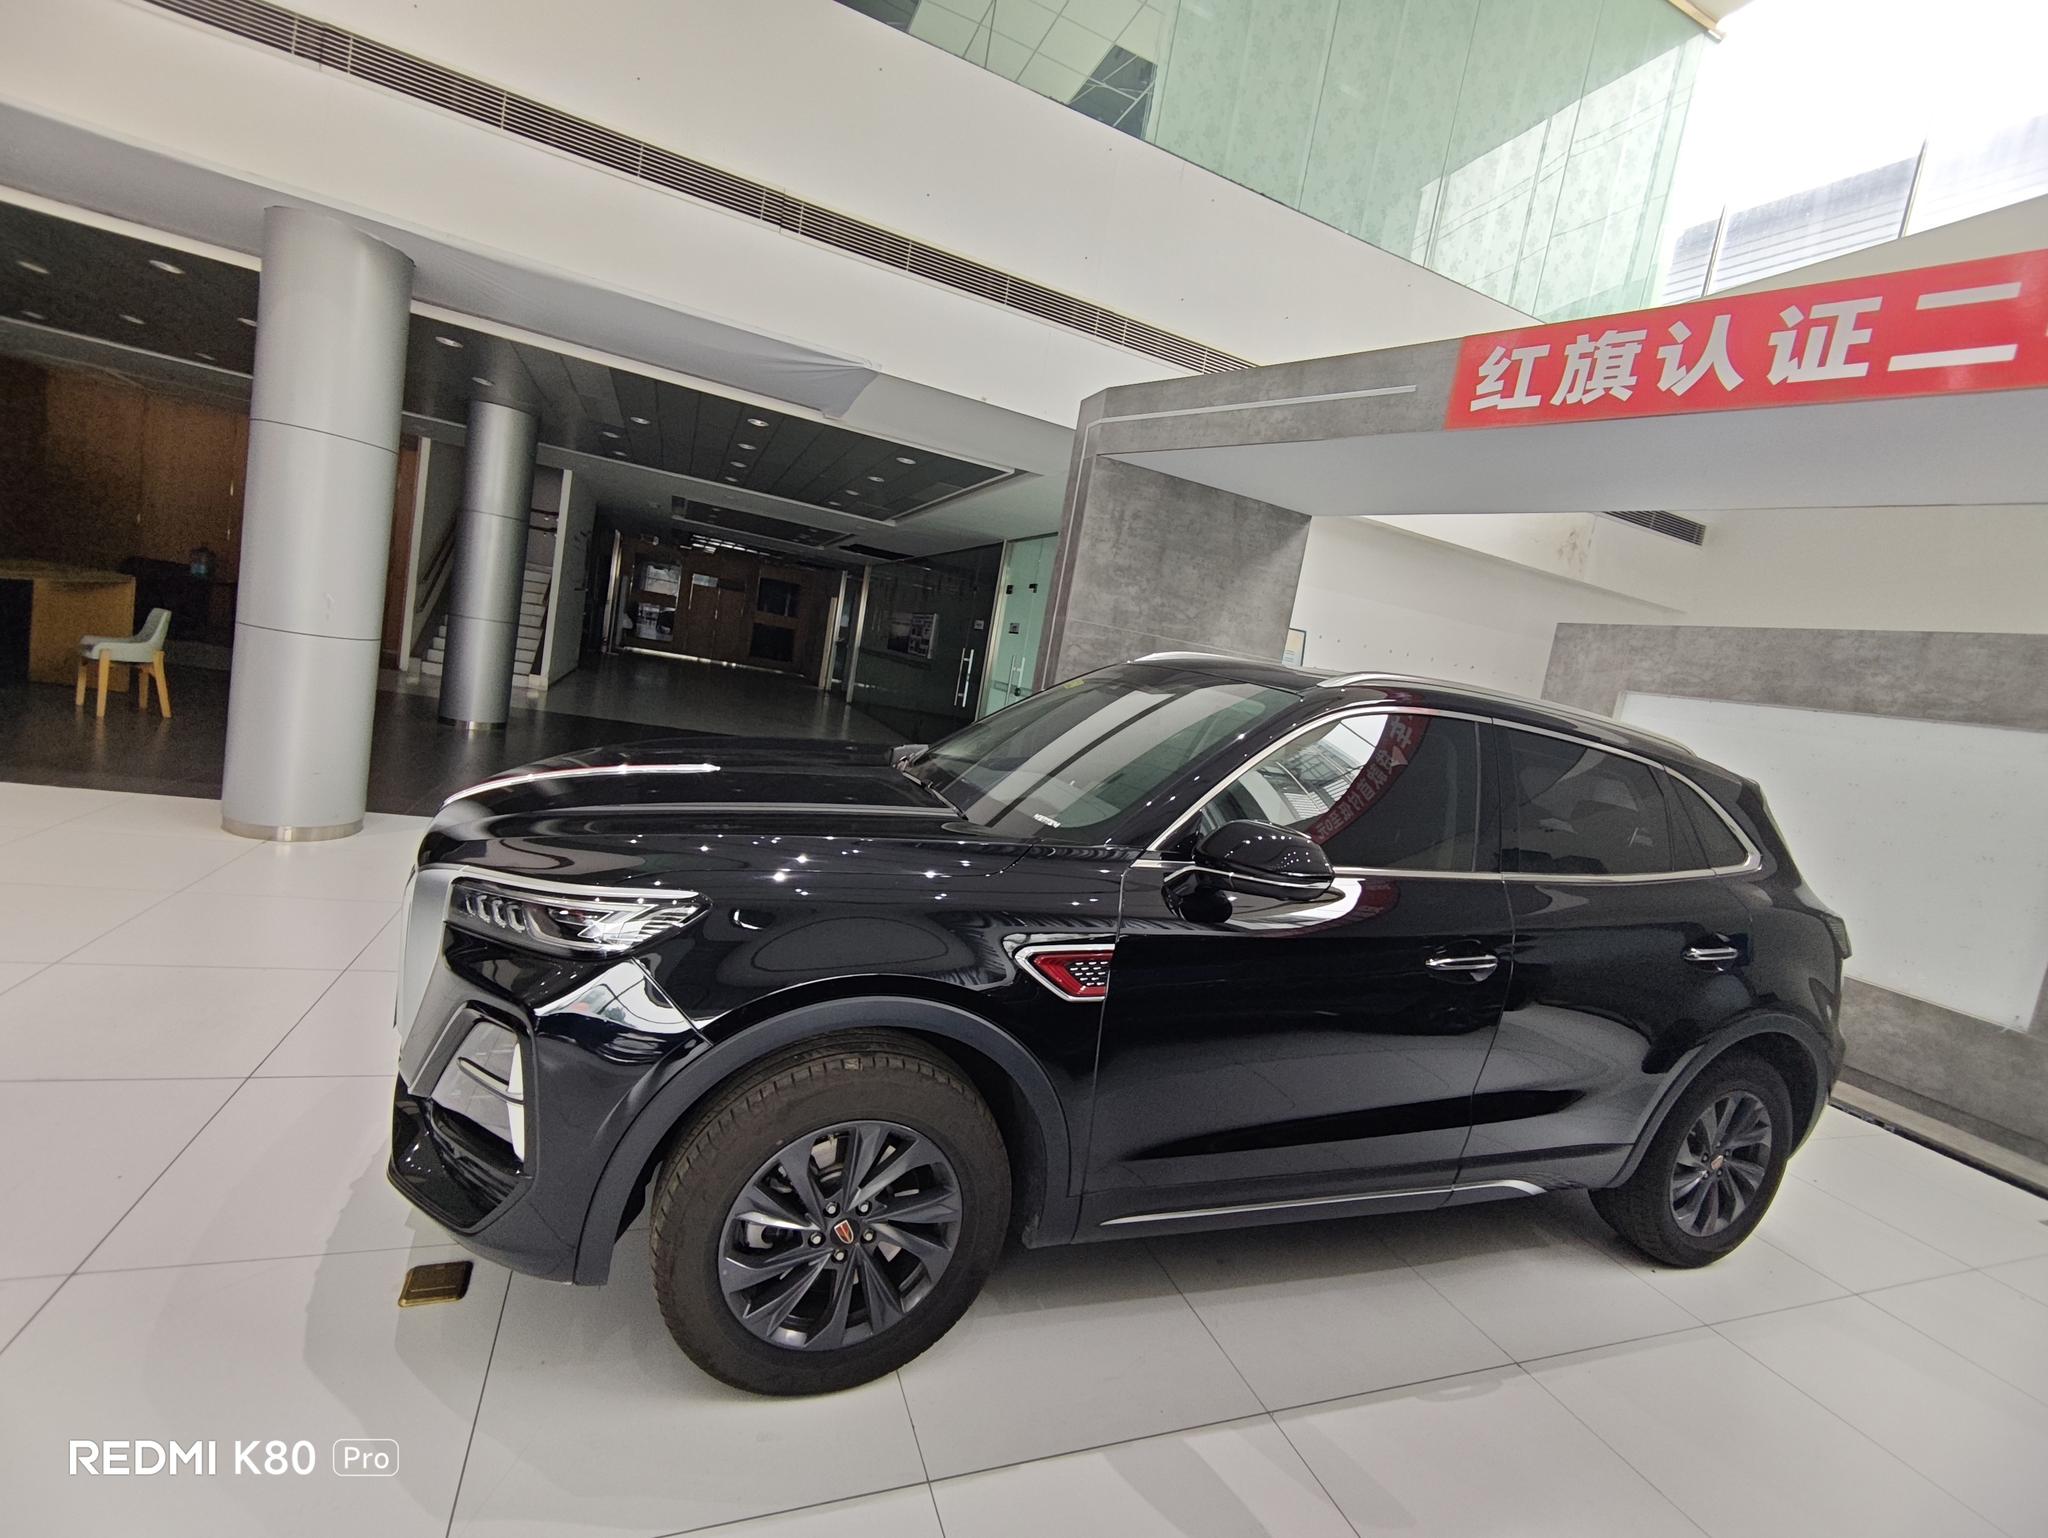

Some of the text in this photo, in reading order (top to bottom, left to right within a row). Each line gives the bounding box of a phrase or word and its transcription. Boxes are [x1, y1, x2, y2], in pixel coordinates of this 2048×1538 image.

[1469, 281, 2022, 412] 红旗认证二
